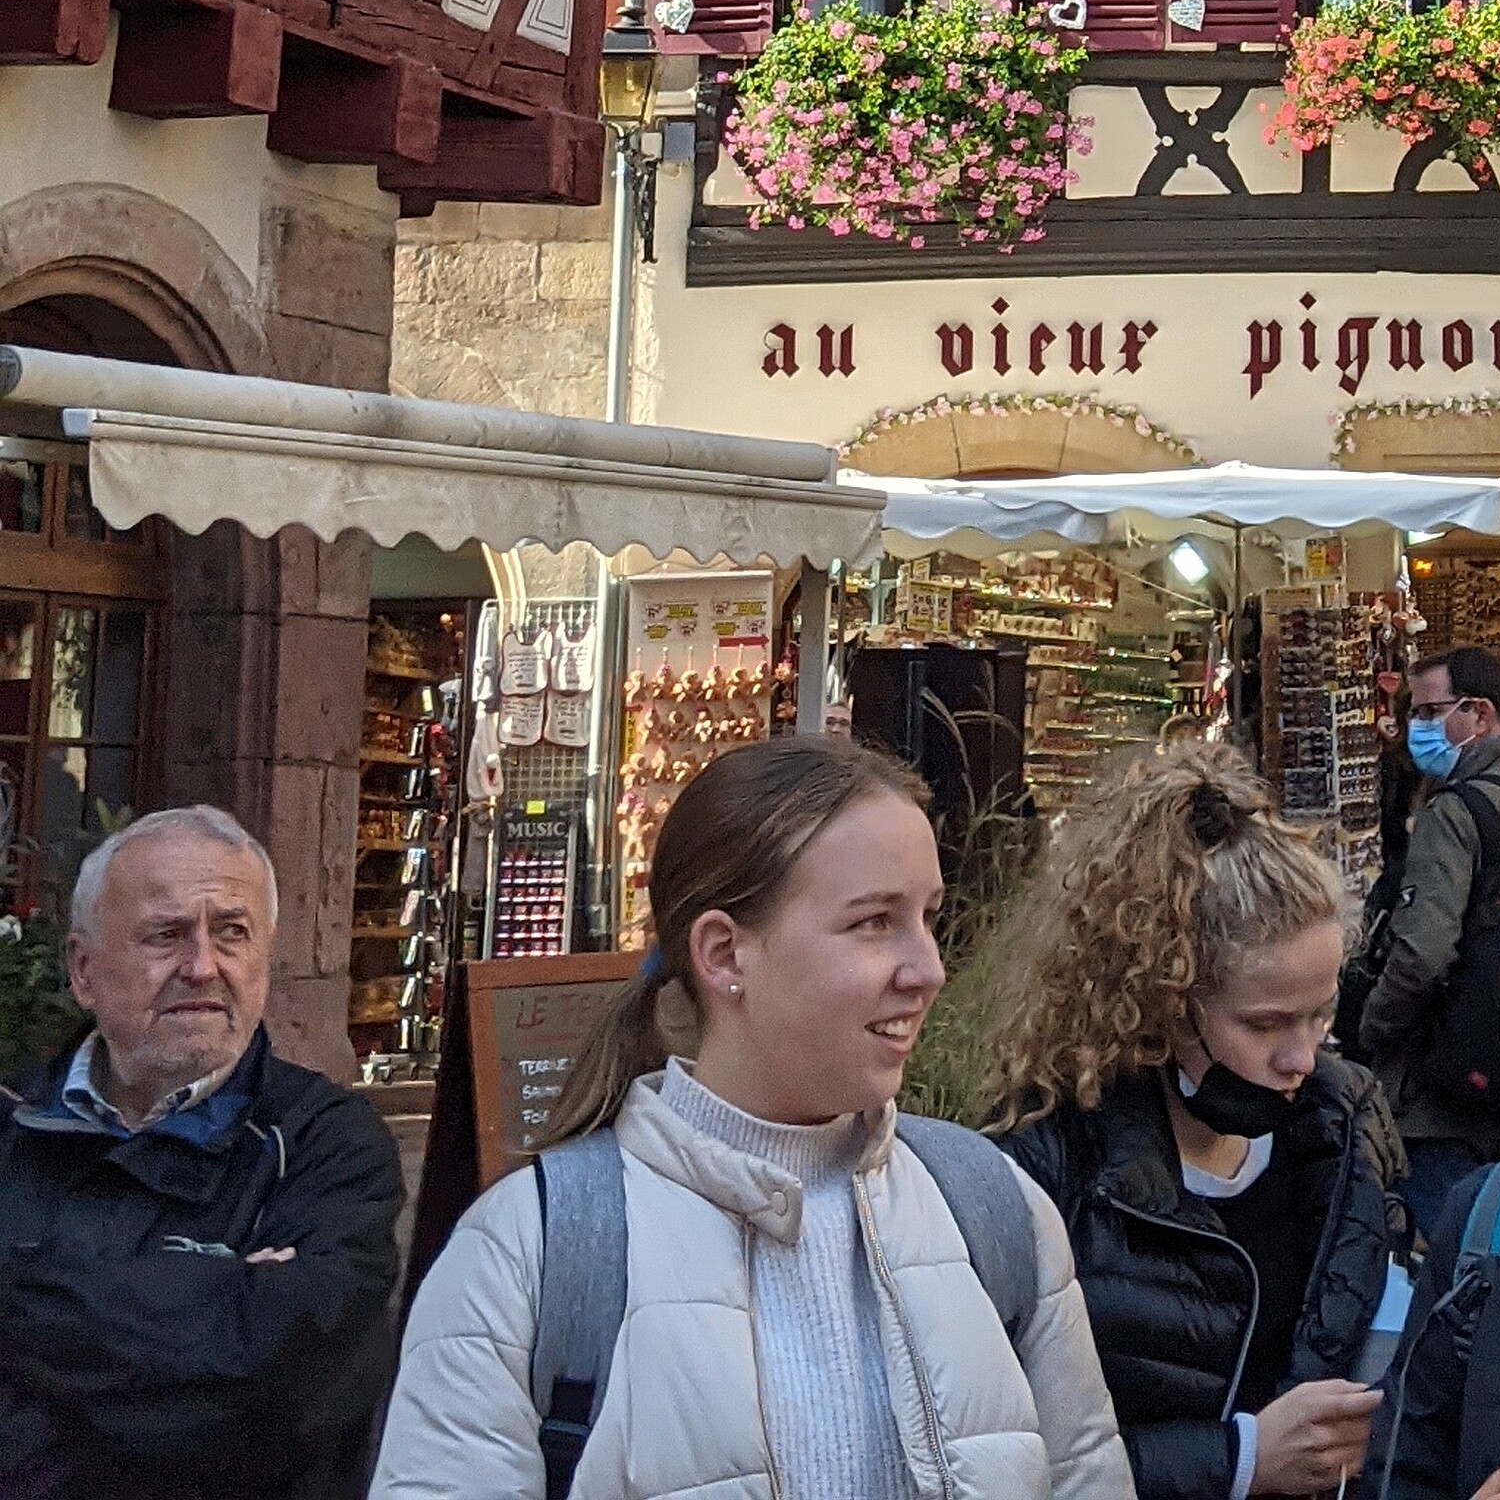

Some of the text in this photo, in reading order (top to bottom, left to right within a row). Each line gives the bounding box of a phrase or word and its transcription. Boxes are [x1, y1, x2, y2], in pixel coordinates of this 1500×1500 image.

[759, 321, 857, 379] au
[934, 296, 1160, 378] vieux
[507, 821, 567, 838] MUSIC
